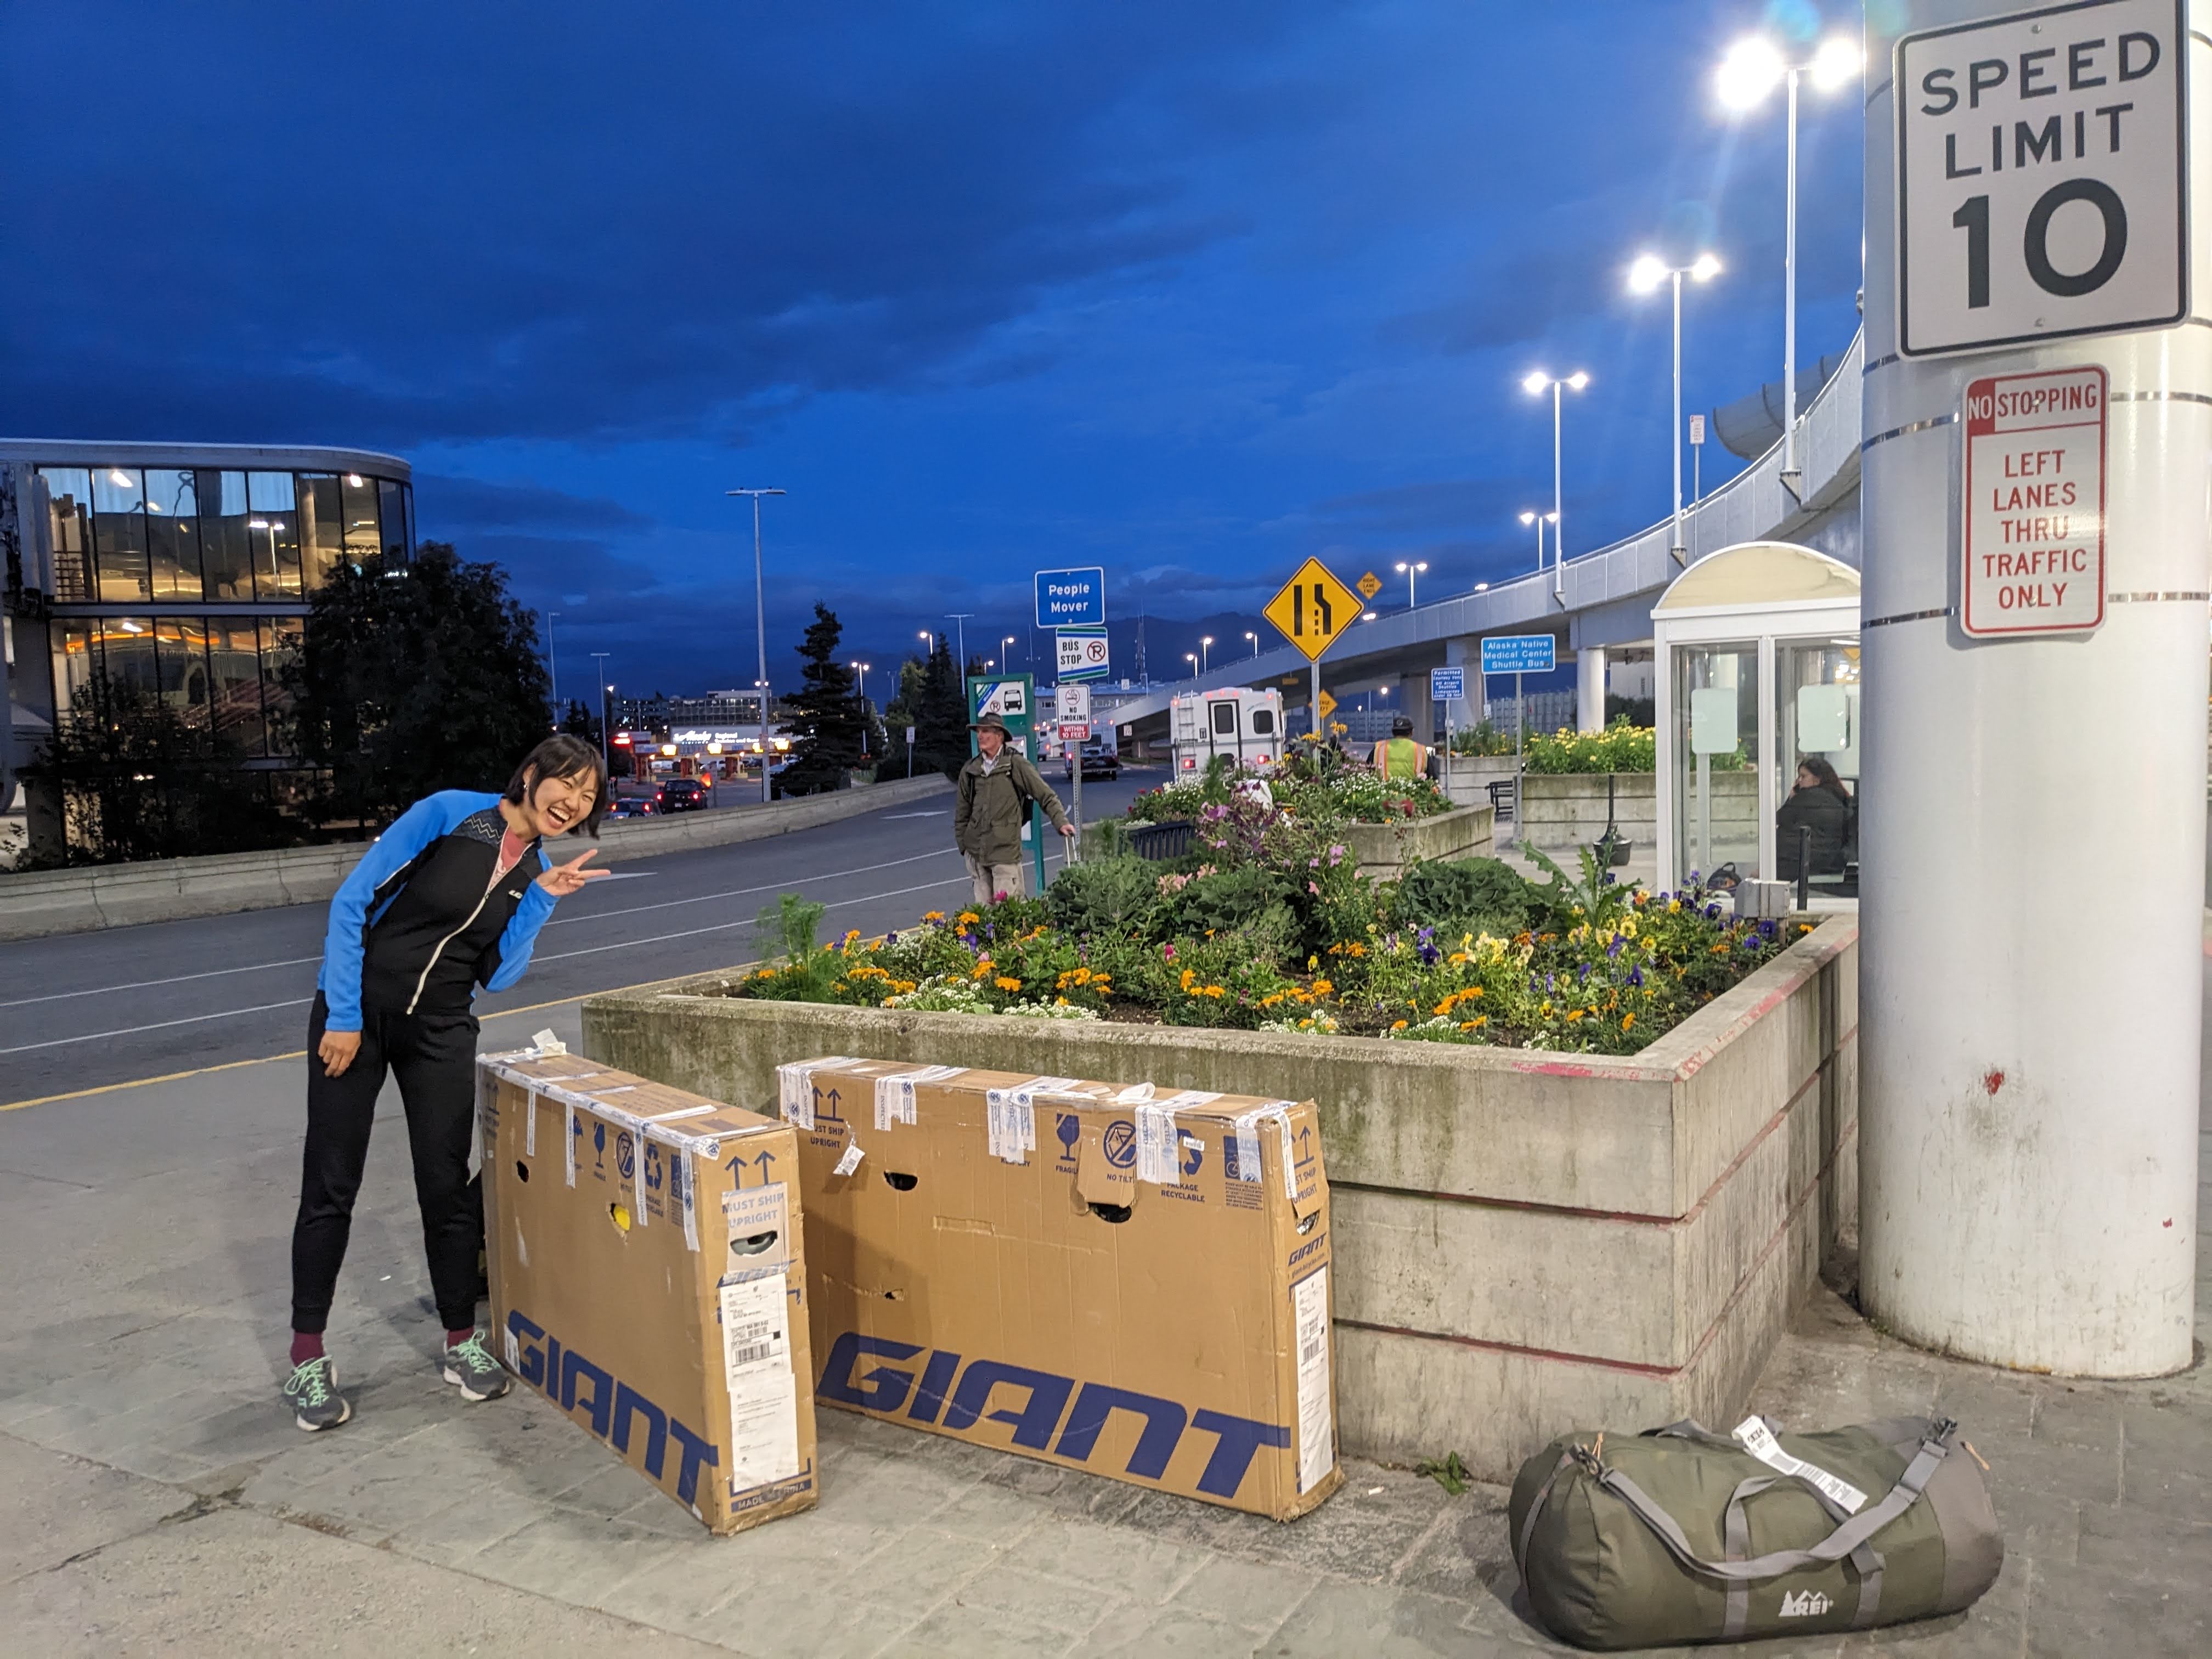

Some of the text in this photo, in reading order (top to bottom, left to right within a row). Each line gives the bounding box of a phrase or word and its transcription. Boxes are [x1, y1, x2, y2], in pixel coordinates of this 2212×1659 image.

[1921, 31, 2161, 116] SPEED
[1945, 103, 2134, 180] LIMIT
[1953, 178, 2128, 309] 10
[1967, 383, 2098, 421] NO STOPPING
[2004, 449, 2066, 478] LEFT
[1993, 482, 2076, 512] LANES
[2000, 516, 2069, 544] THRU
[1982, 549, 2087, 578] TRAFFIC
[1048, 583, 1090, 597] People
[1998, 582, 2068, 610] ONLY
[1051, 601, 1088, 613] Mover
[1062, 641, 1079, 651] BUS
[1060, 654, 1082, 665] STOP
[1484, 651, 1518, 659] Medical
[1492, 661, 1523, 669] Shuttle
[1060, 714, 1087, 722] SMOKING
[509, 890, 523, 899] LG
[815, 1125, 844, 1136] UST SHIP
[810, 1136, 840, 1149] UPRIGHT
[1056, 1165, 1079, 1175] FRAGIL
[1107, 1173, 1134, 1184] NO TILT
[1303, 1167, 1317, 1179] SHIP
[1161, 1189, 1205, 1203] RECYCLABLE
[1293, 1183, 1317, 1204] UPRIGHT
[722, 1192, 784, 1214] MUST SHIP
[729, 1209, 778, 1228] UPRIGHT
[1288, 1231, 1327, 1267] GIANT
[508, 1309, 719, 1505] GIANT
[815, 1331, 1291, 1499] GIANT
[1795, 1600, 1828, 1616] REI
